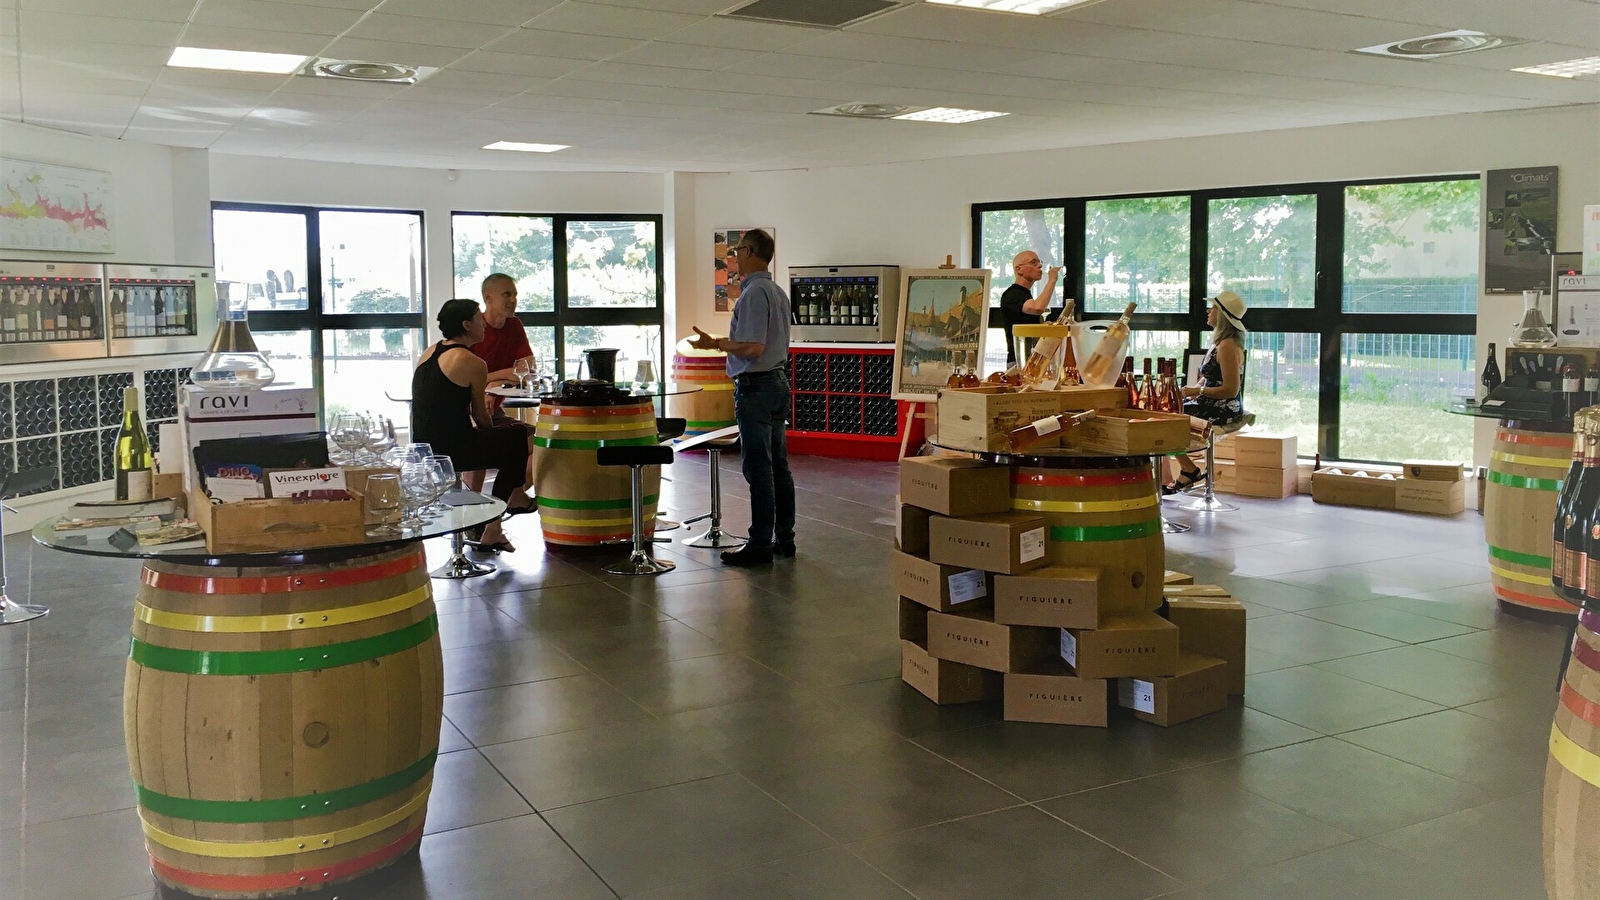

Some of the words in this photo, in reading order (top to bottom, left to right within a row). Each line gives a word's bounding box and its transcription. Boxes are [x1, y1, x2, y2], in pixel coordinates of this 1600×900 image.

[1563, 277, 1586, 285] ravi
[200, 395, 248, 409] ravi
[275, 472, 339, 483] Vinexplore
[976, 580, 984, 588] 21
[1143, 694, 1152, 703] 21
